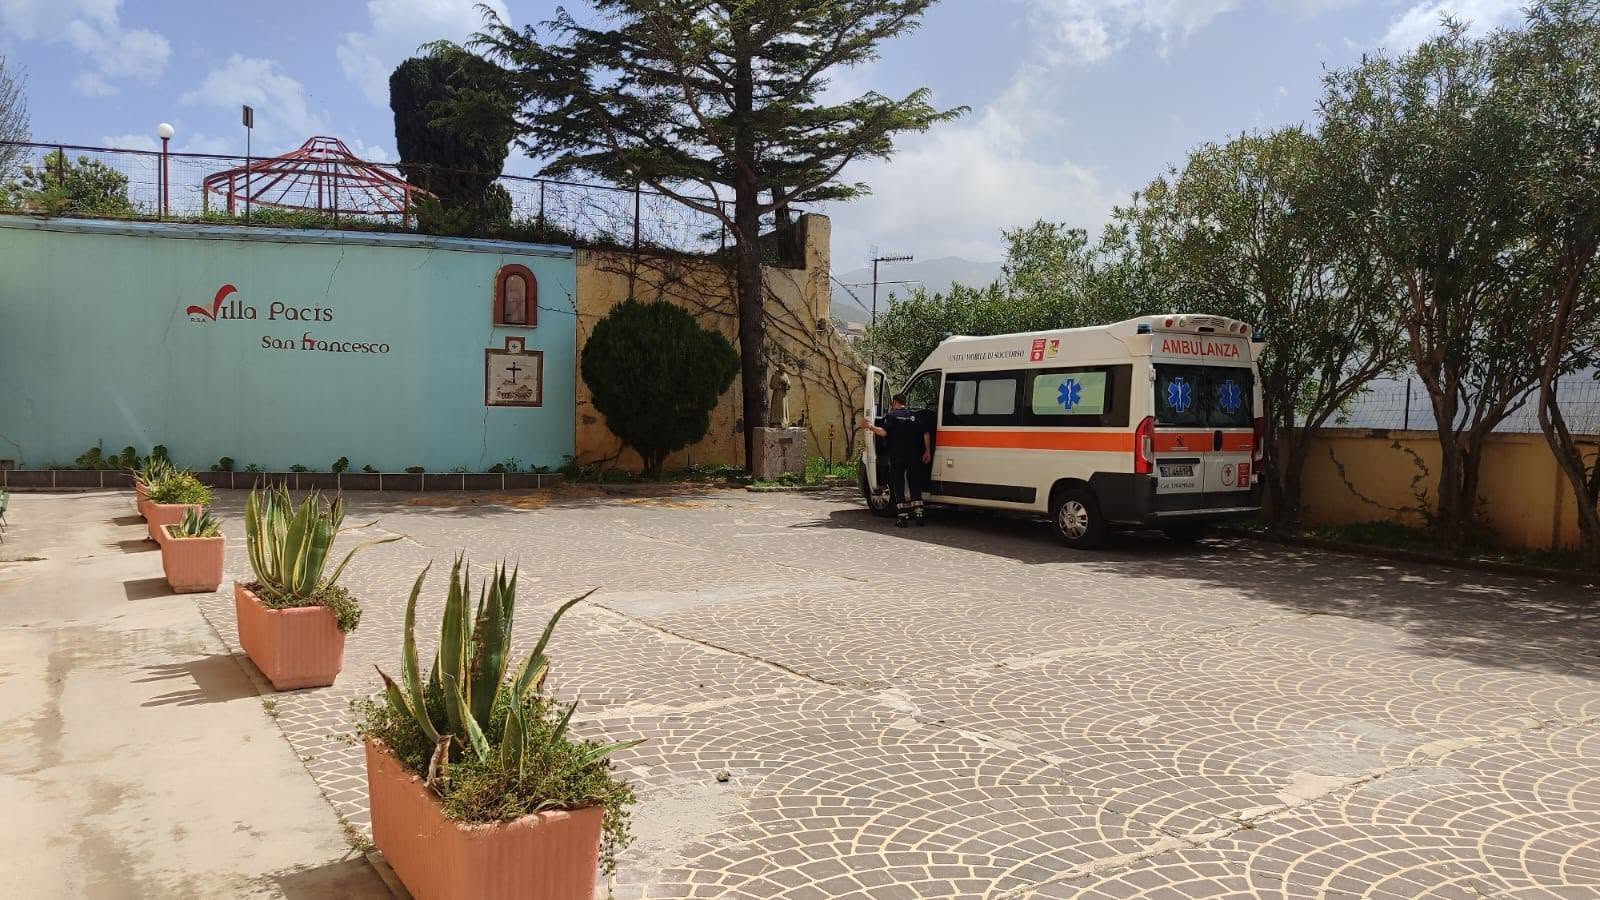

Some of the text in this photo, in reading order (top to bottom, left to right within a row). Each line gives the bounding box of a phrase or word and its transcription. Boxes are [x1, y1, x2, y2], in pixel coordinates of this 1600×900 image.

[268, 301, 333, 322] Pacis
[261, 335, 296, 350] San
[1162, 339, 1240, 358] AMBULANZA
